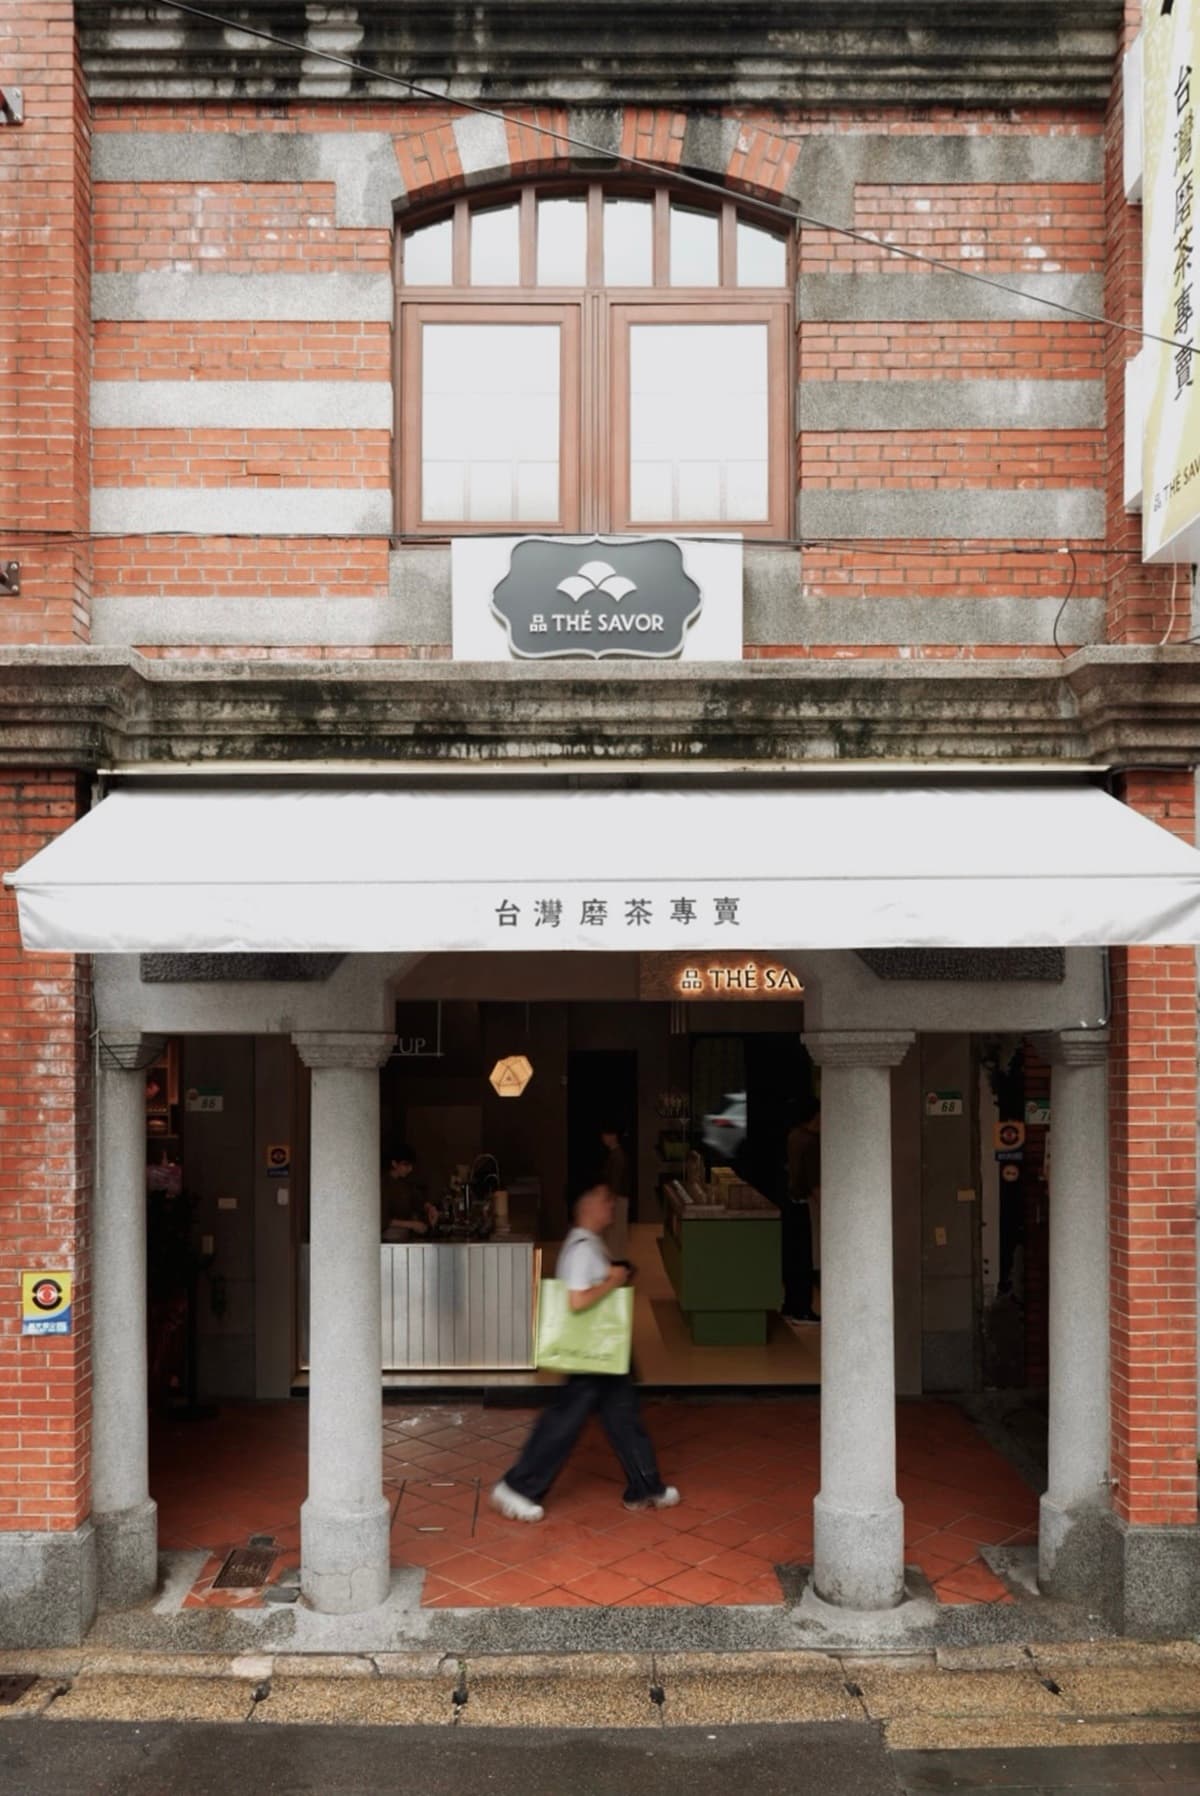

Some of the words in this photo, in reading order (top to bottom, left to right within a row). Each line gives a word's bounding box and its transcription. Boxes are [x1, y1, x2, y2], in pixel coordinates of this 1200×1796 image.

[529, 614, 547, 632] 品
[552, 610, 592, 631] THÉ
[598, 614, 664, 631] SAVOR
[495, 897, 741, 928] 台灣磨茶專賣
[682, 968, 702, 989] 品
[709, 963, 757, 989] THÉ
